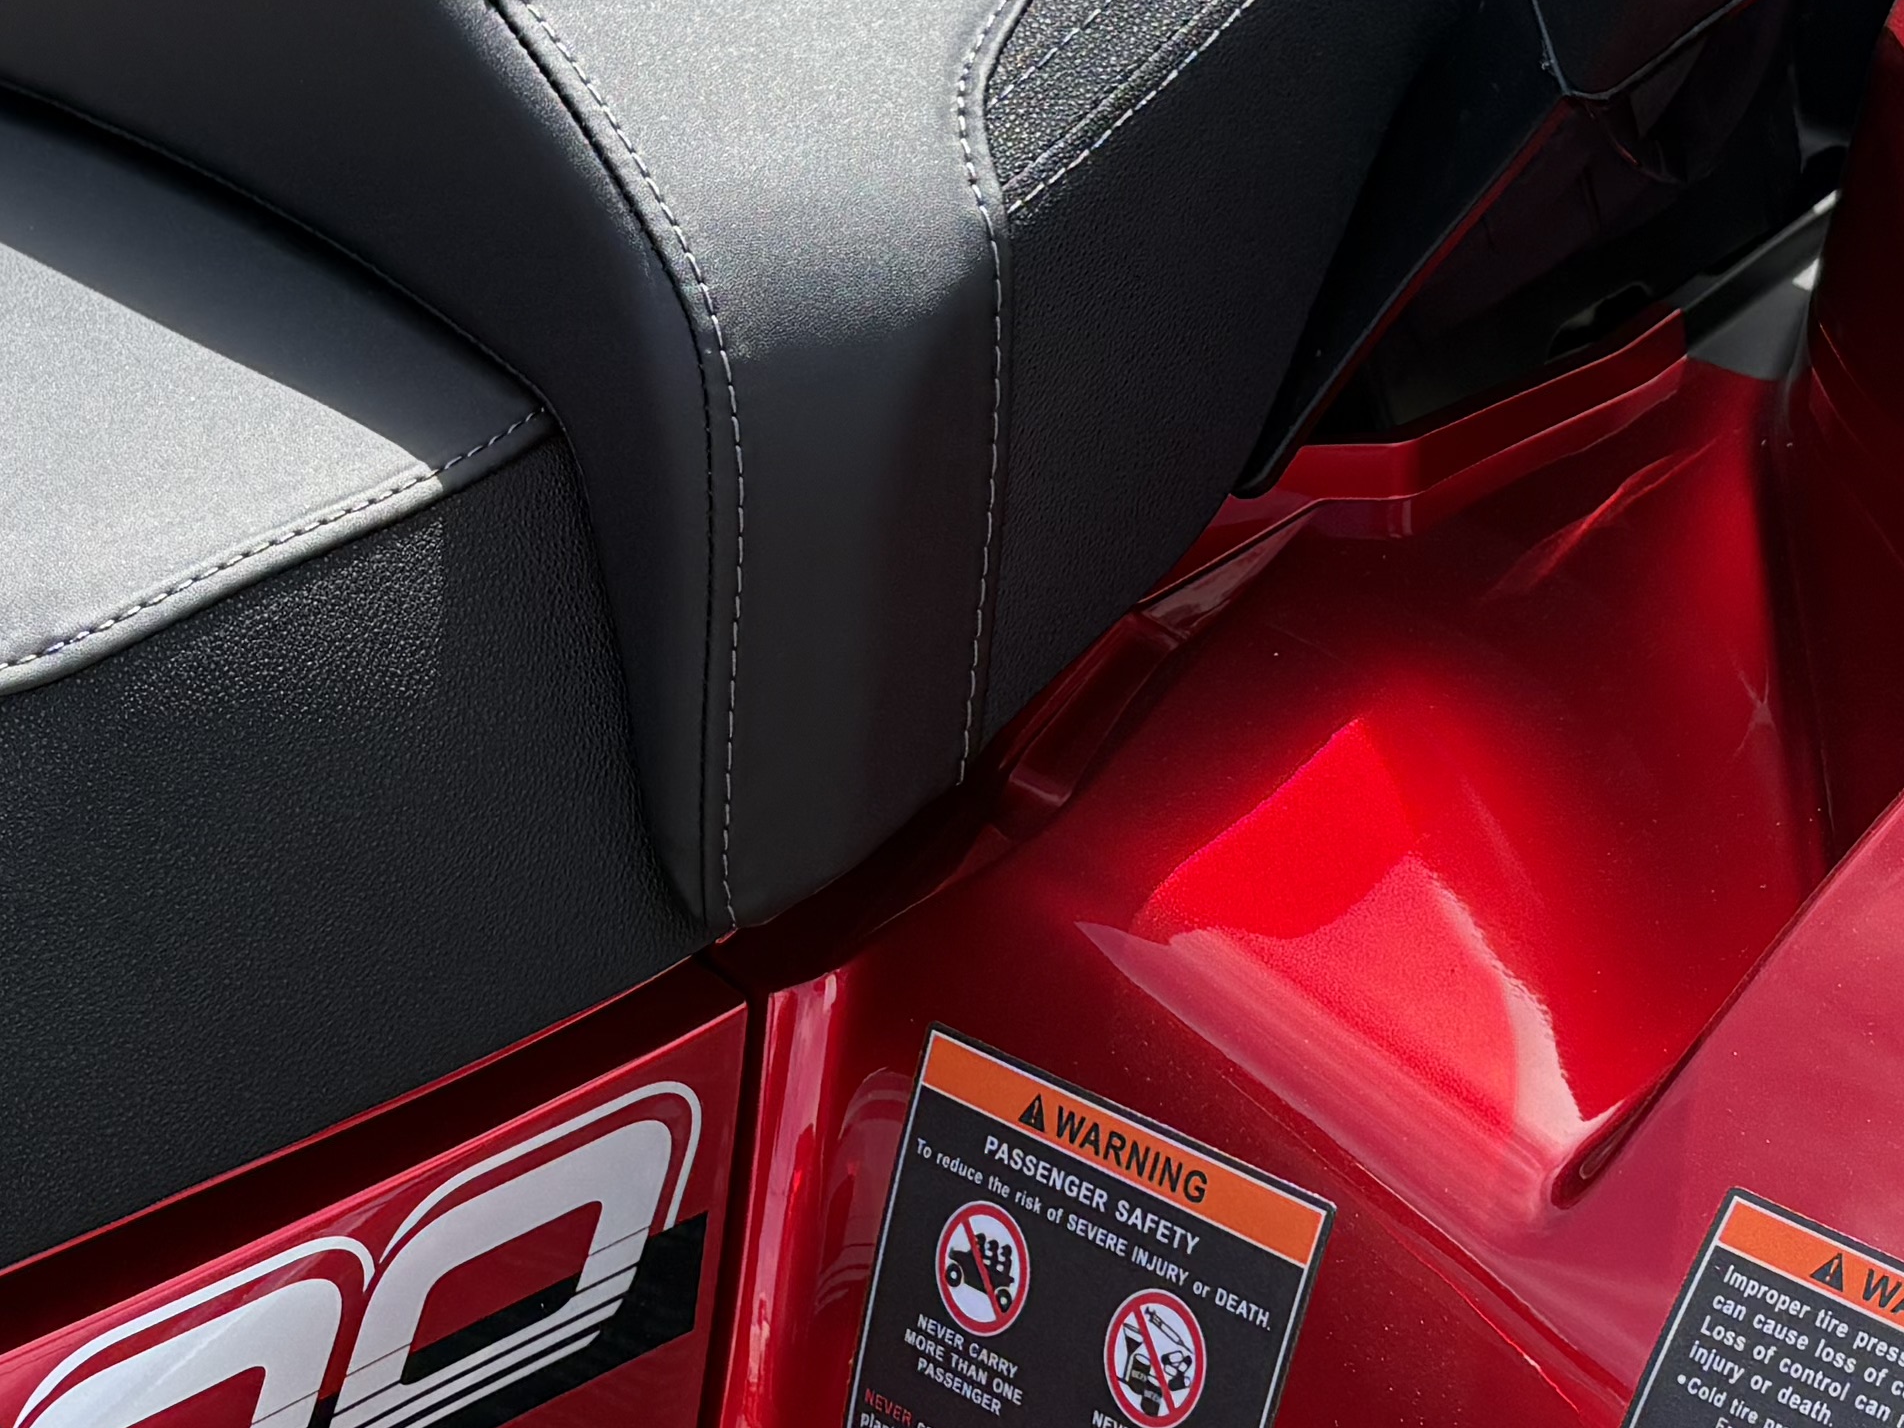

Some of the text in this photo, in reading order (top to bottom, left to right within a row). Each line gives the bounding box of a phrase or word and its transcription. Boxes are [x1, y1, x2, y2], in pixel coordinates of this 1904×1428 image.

[984, 1135, 1200, 1254] PASSENGER SAFETY
[1056, 1105, 1208, 1203] WARNING
[917, 1137, 1270, 1331] To reduce the risk of SEVERE INJURY or DEATH.
[1712, 1295, 1746, 1321] can
[1752, 1313, 1809, 1350] cause
[1814, 1338, 1857, 1373] loss
[1863, 1366, 1889, 1386] of
[1723, 1264, 1811, 1318] Improper
[1814, 1308, 1849, 1338] tire
[904, 1328, 1023, 1405] MORE THAN ONE
[917, 1313, 1018, 1378] NEVER CARRY
[917, 1357, 1001, 1416] PASSENGER
[1689, 1340, 1833, 1427] injury or death.
[1700, 1314, 1746, 1351] Loss
[1752, 1345, 1777, 1364] of
[1778, 1357, 1851, 1401] control
[1854, 1394, 1891, 1422] can
[865, 1388, 912, 1424] NEVER
[1687, 1377, 1727, 1408] Cold
[1729, 1398, 1758, 1424] tire
